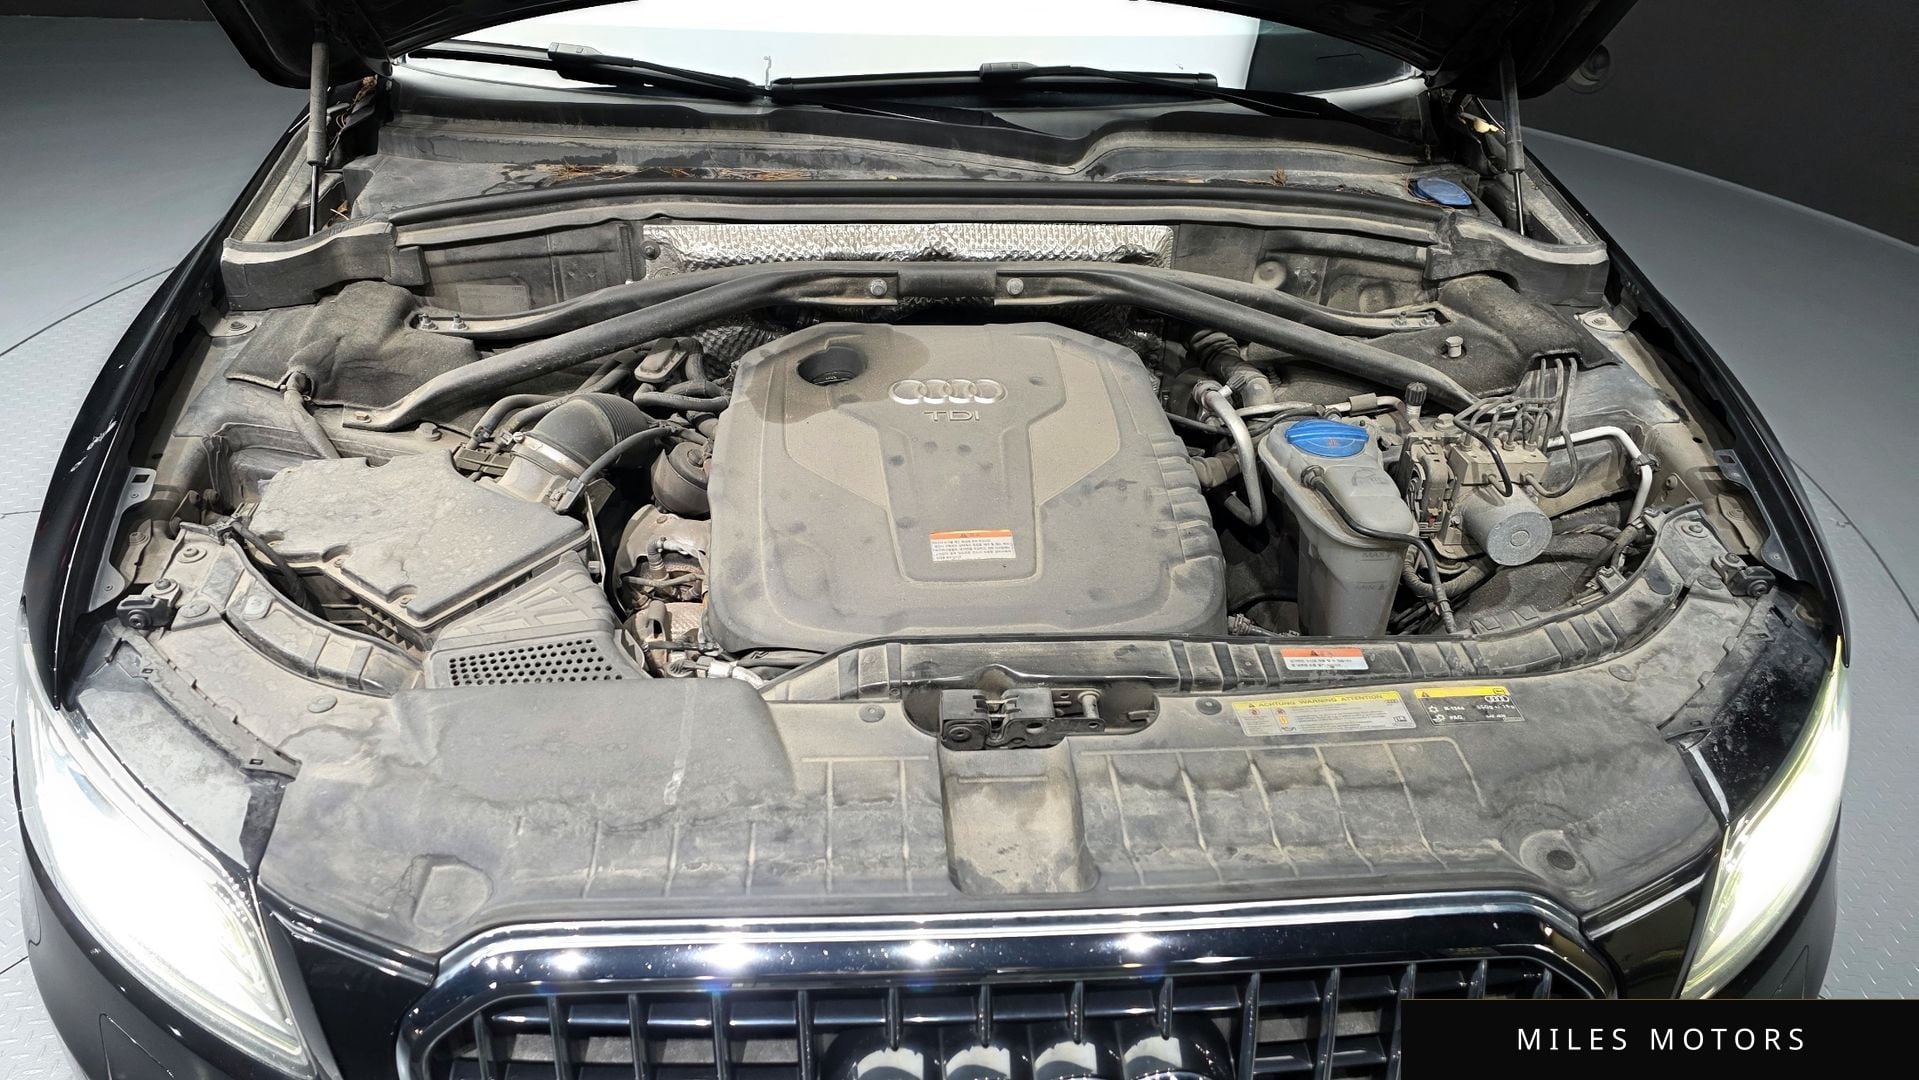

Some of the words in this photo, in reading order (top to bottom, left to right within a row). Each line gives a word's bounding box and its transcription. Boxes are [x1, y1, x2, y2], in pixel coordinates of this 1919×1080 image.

[924, 410, 980, 422] TDI
[1299, 697, 1338, 705] WARNING
[1340, 694, 1384, 702] ATTENTION
